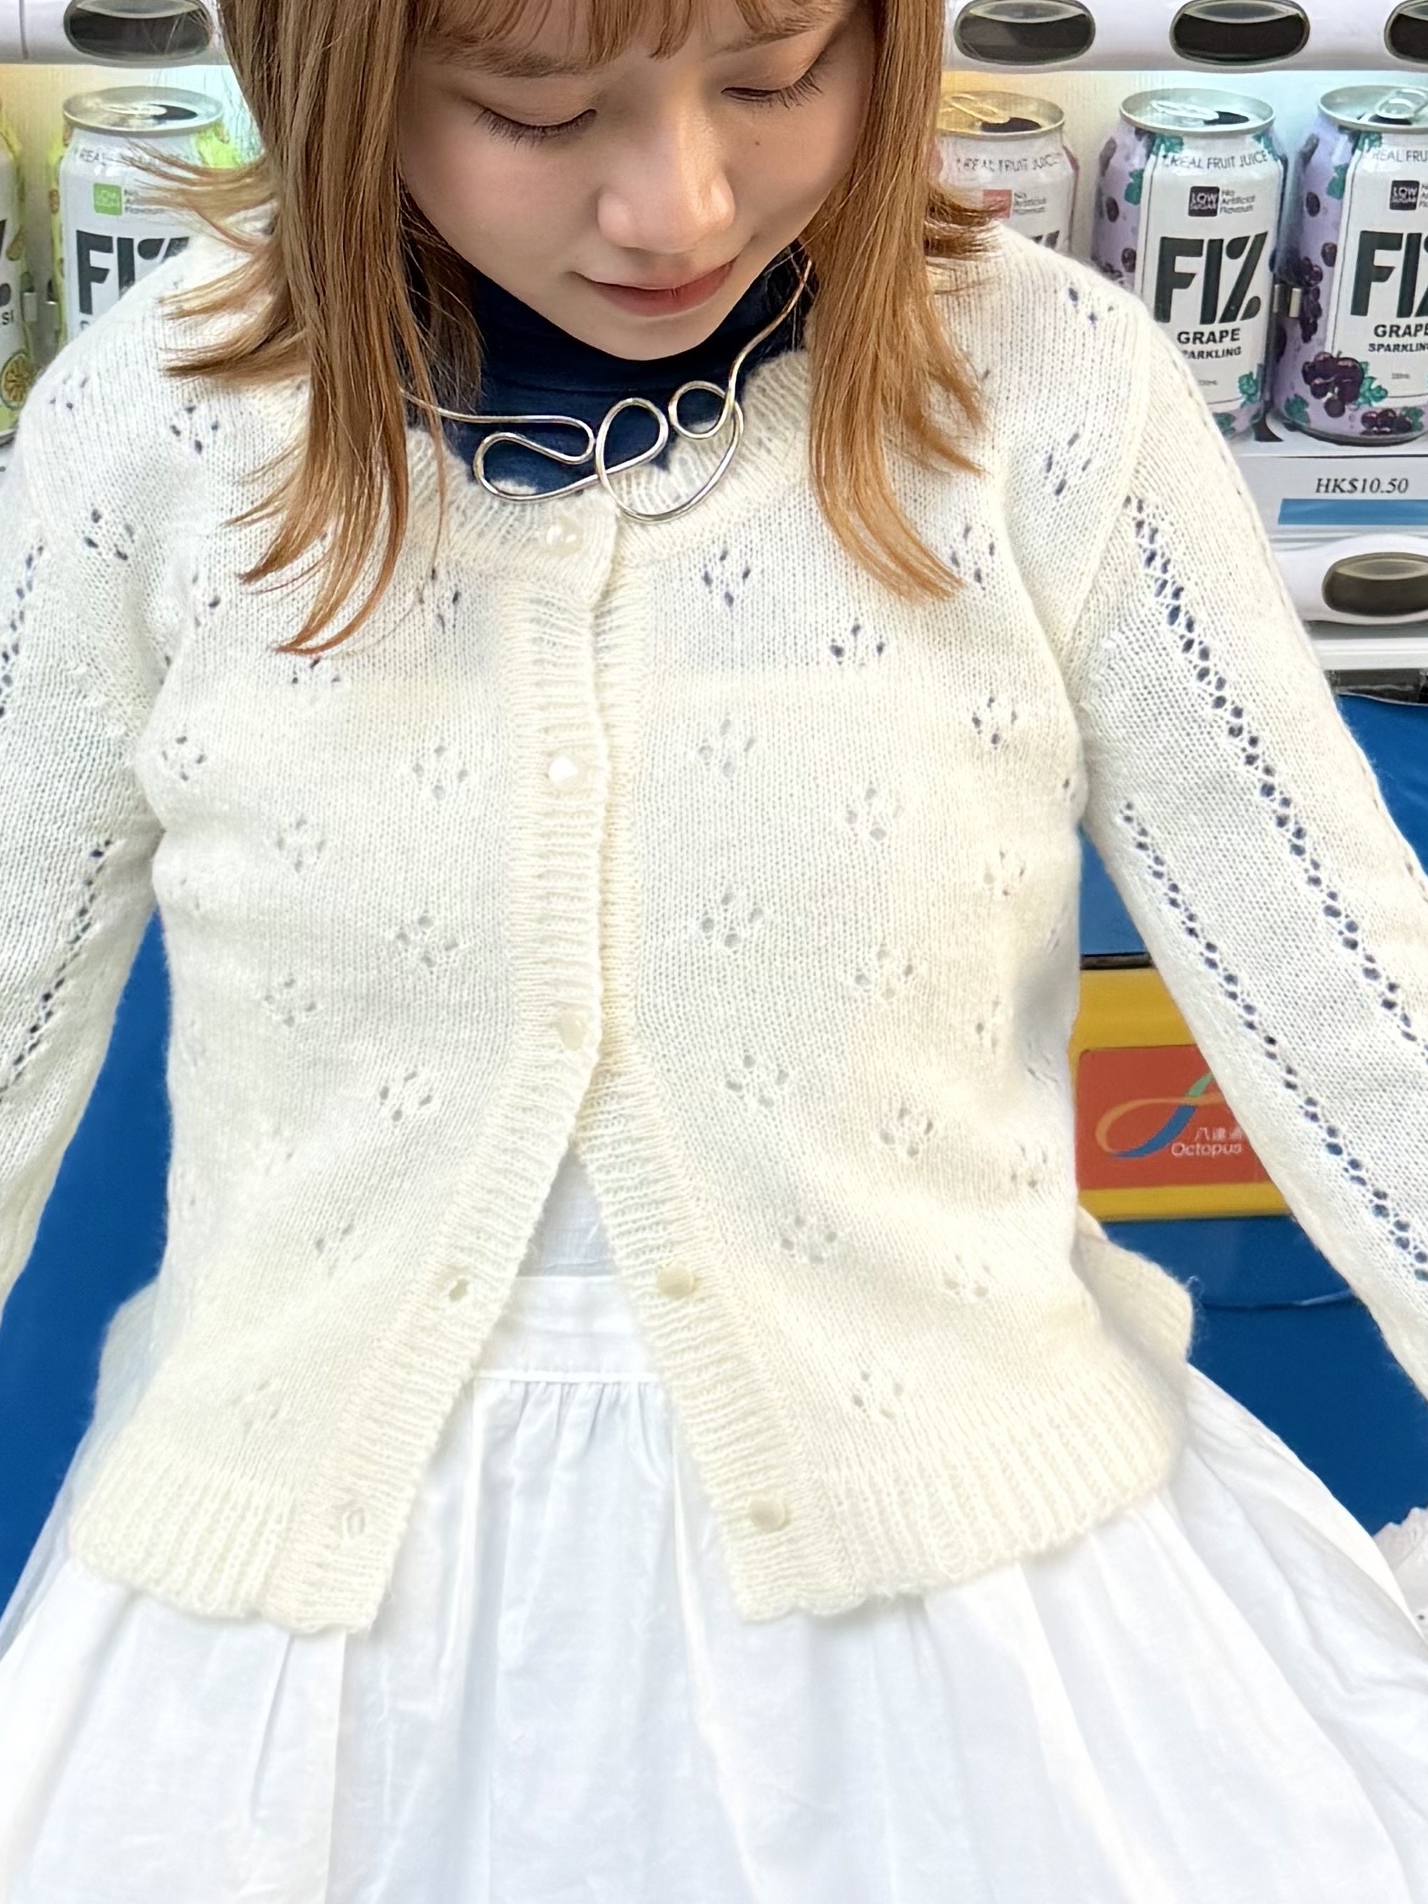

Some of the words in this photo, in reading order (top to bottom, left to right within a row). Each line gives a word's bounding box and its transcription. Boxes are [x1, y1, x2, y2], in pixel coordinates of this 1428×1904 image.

[1155, 231, 1269, 325] FIZ
[1177, 328, 1241, 345] GRAPE
[1316, 478, 1409, 494] HK$10.50
[1172, 1142, 1242, 1158] Octopus
